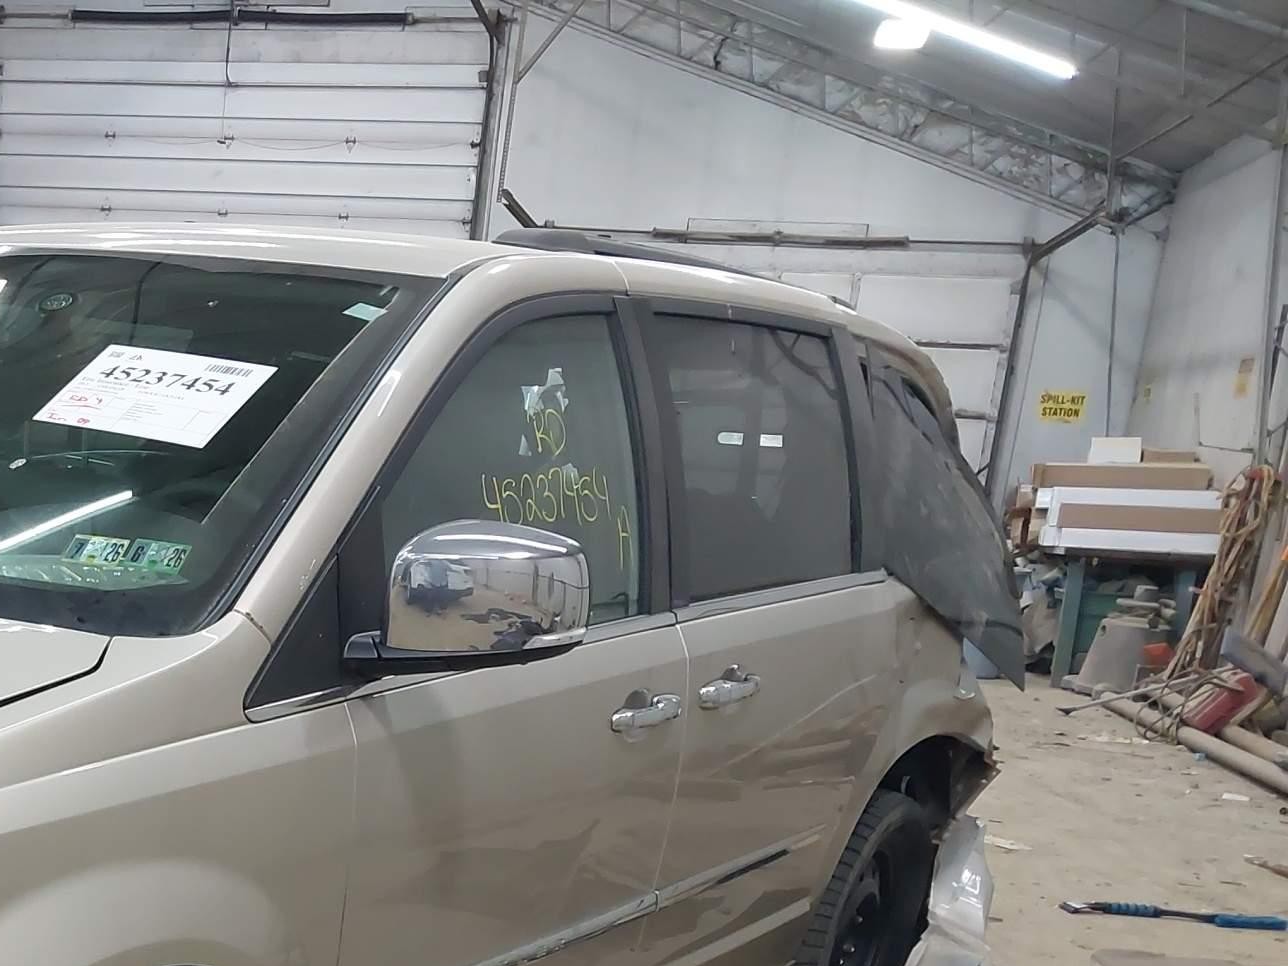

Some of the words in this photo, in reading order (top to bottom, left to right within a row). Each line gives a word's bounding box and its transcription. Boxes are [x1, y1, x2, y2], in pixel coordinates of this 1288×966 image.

[100, 364, 237, 396] 45237454
[1040, 394, 1086, 406] SPILL-KIT
[1041, 406, 1080, 417] STATION
[481, 465, 611, 526] 45237454
[69, 541, 83, 560] 7
[104, 542, 125, 563] 26
[130, 545, 145, 563] 6
[165, 547, 187, 568] 26
